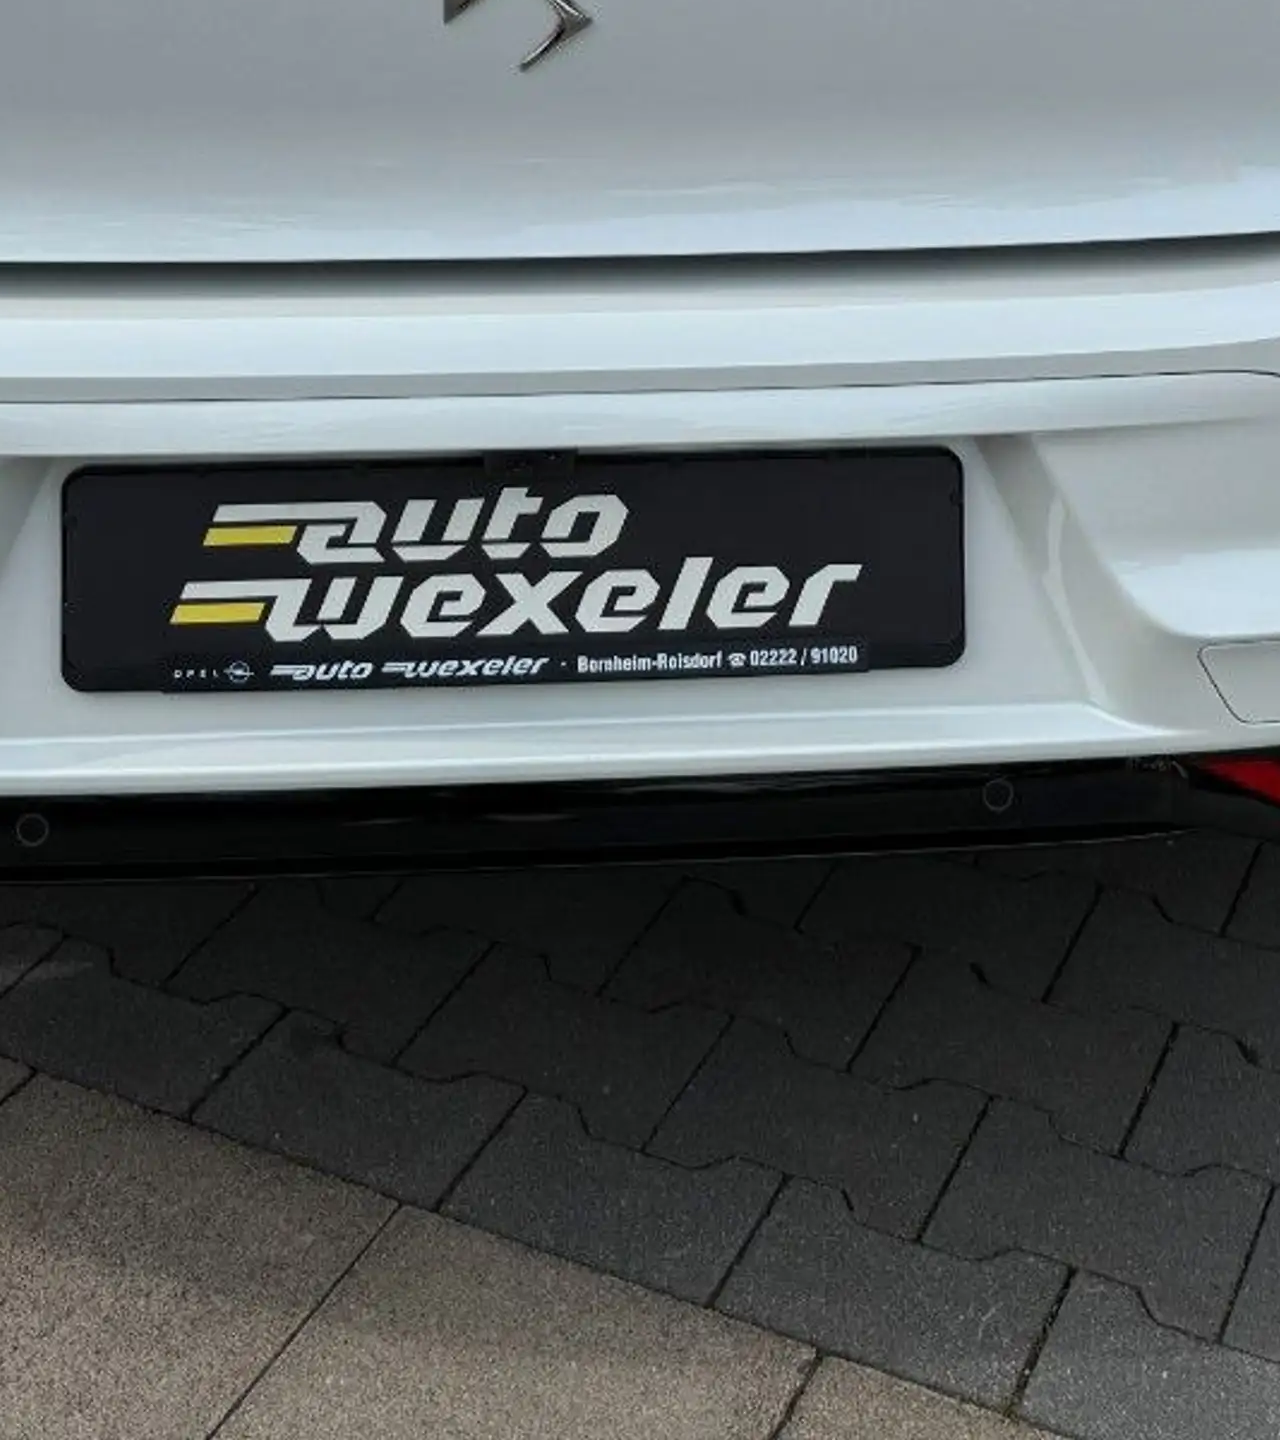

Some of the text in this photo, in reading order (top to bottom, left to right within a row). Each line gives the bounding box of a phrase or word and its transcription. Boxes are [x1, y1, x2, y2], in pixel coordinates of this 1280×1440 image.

[208, 487, 629, 565] auto
[177, 557, 862, 643] wexeler
[270, 659, 374, 681] auto
[381, 656, 549, 678] wexeler
[576, 651, 723, 673] Bornheim-Roisdorf
[749, 648, 797, 666] 02222
[810, 646, 858, 664] 91020
